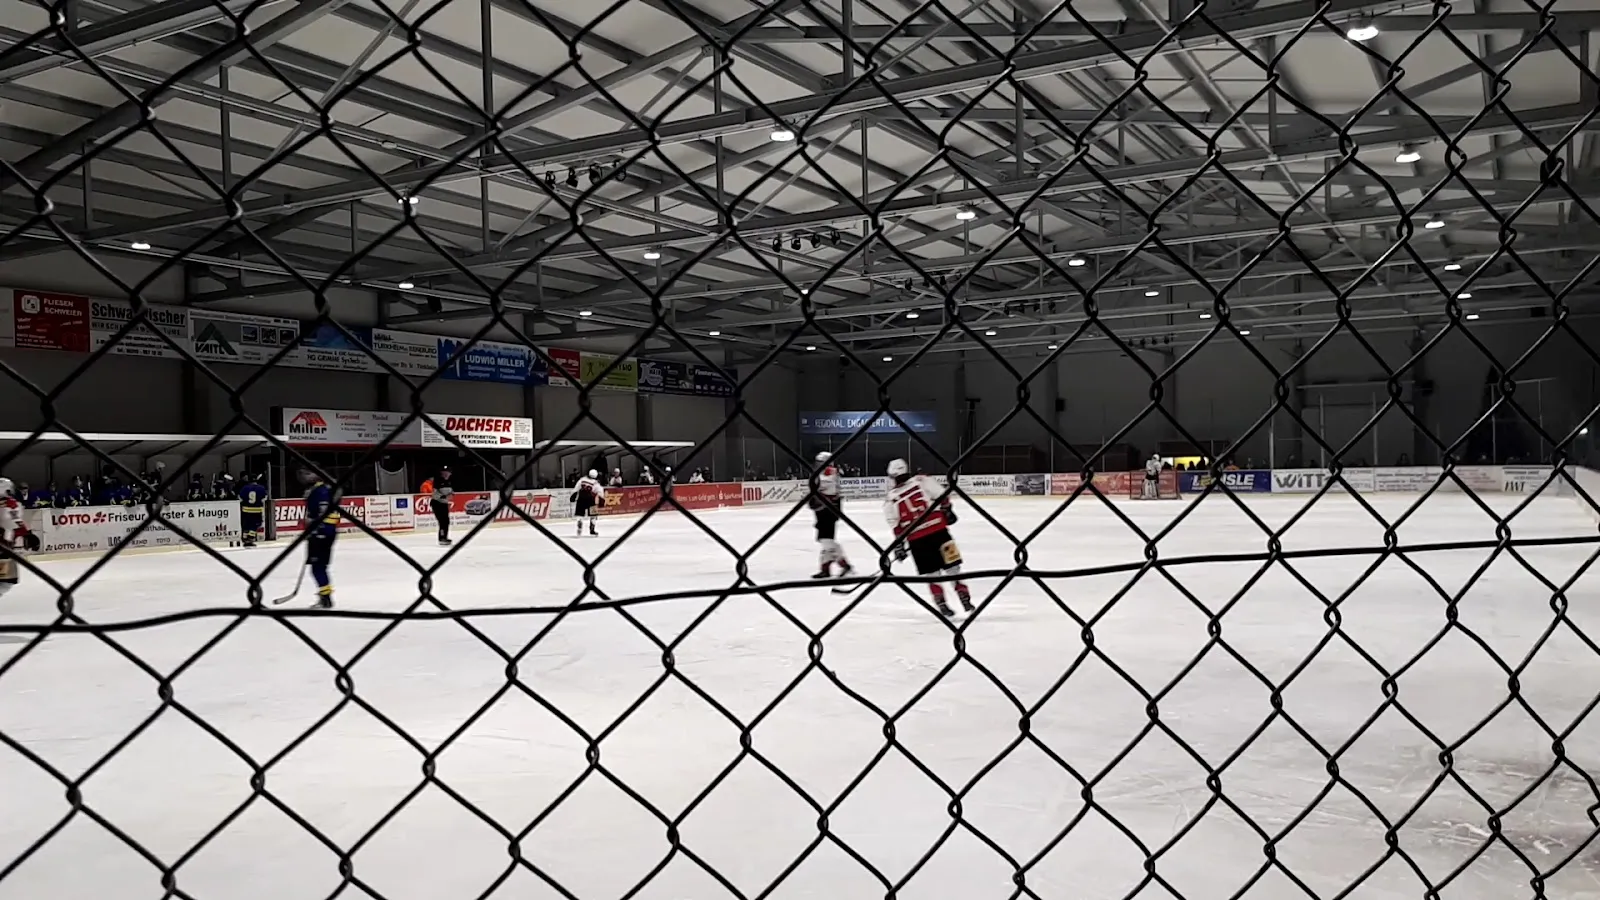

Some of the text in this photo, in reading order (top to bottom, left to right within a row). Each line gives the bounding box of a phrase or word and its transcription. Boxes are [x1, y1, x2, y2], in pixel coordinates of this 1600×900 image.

[44, 298, 73, 308] FLIESEN
[464, 354, 526, 368] LUDWIG MILLER
[445, 417, 513, 433] DACHSER
[248, 490, 257, 504] 9
[51, 513, 91, 526] LOTTO
[108, 511, 147, 523] Friseur
[187, 509, 195, 518] &
[198, 508, 229, 519] Haugg
[54, 543, 76, 551] LOTTO
